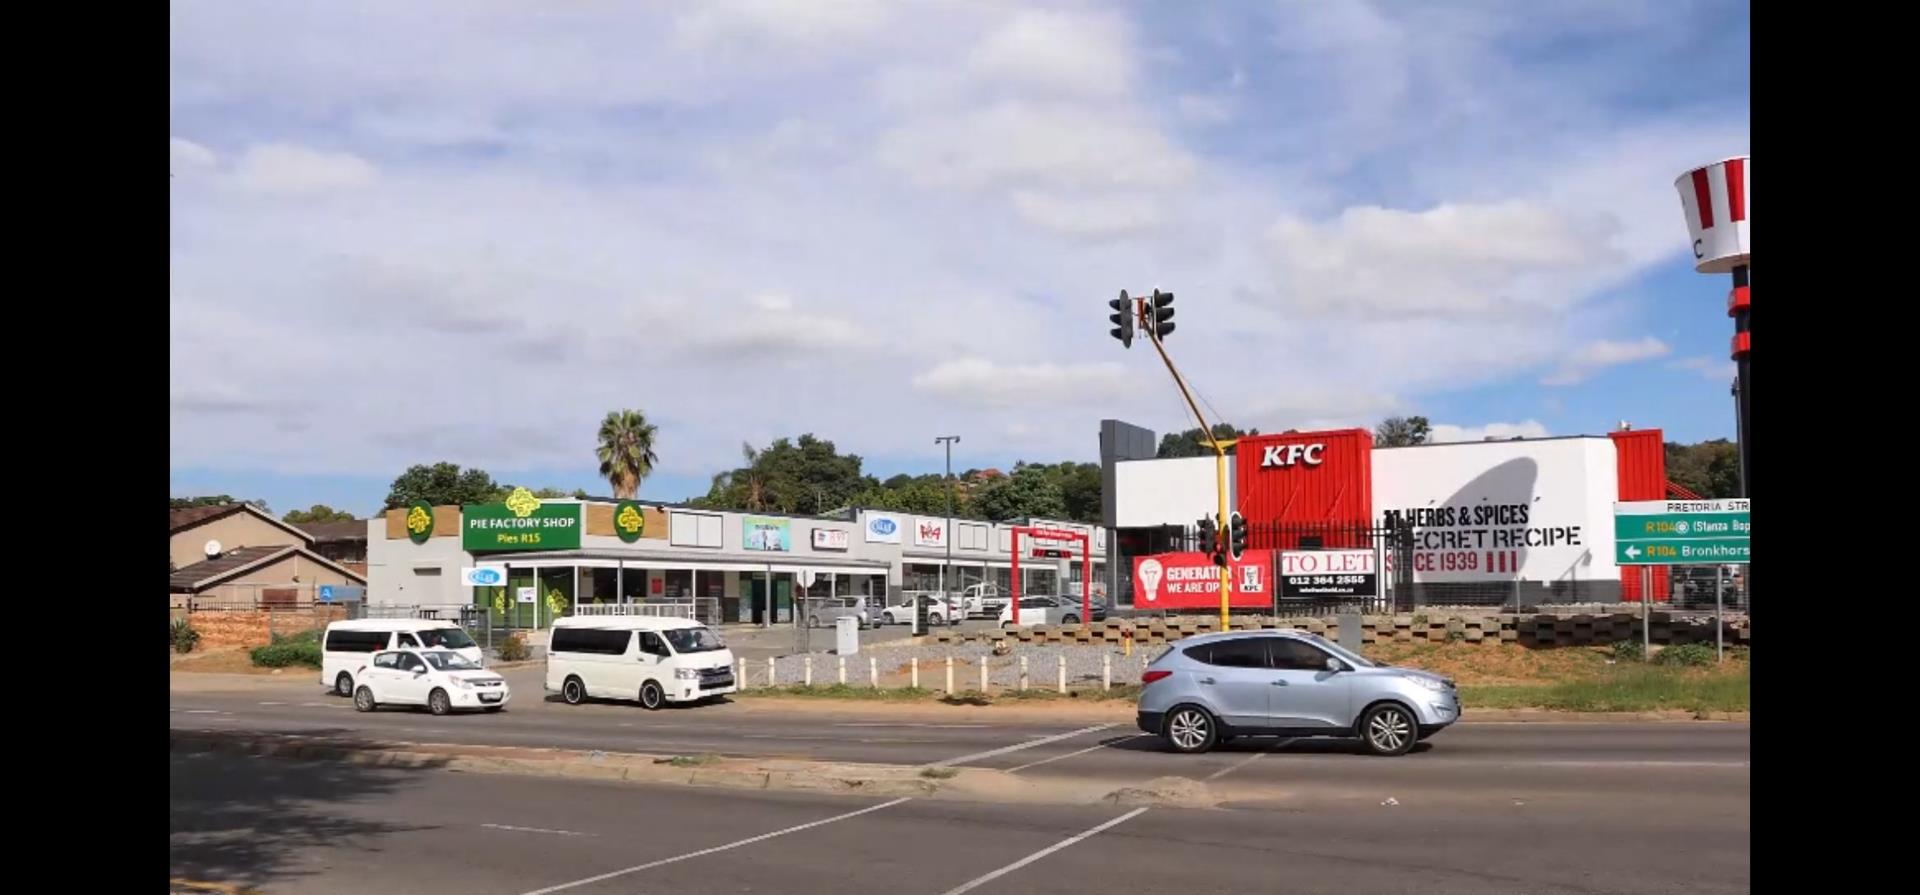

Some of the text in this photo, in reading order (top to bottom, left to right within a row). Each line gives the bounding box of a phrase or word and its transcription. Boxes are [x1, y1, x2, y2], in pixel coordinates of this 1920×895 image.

[1261, 443, 1323, 467] KFC
[1667, 502, 1721, 512] PRETORIA
[1406, 506, 1455, 527] HERBS
[1459, 506, 1472, 526] &
[1473, 504, 1529, 525] SPICES
[470, 517, 575, 529] PIE FACTORY SHOP
[497, 533, 541, 543] Pies R15
[1399, 526, 1581, 550] ECRET RECIPE
[1647, 546, 1677, 557] R104
[1283, 553, 1375, 573] TO LET
[1386, 551, 1478, 572] SCE 1939
[1289, 576, 1310, 585] 012
[1167, 582, 1233, 593] WE ARE OPN
